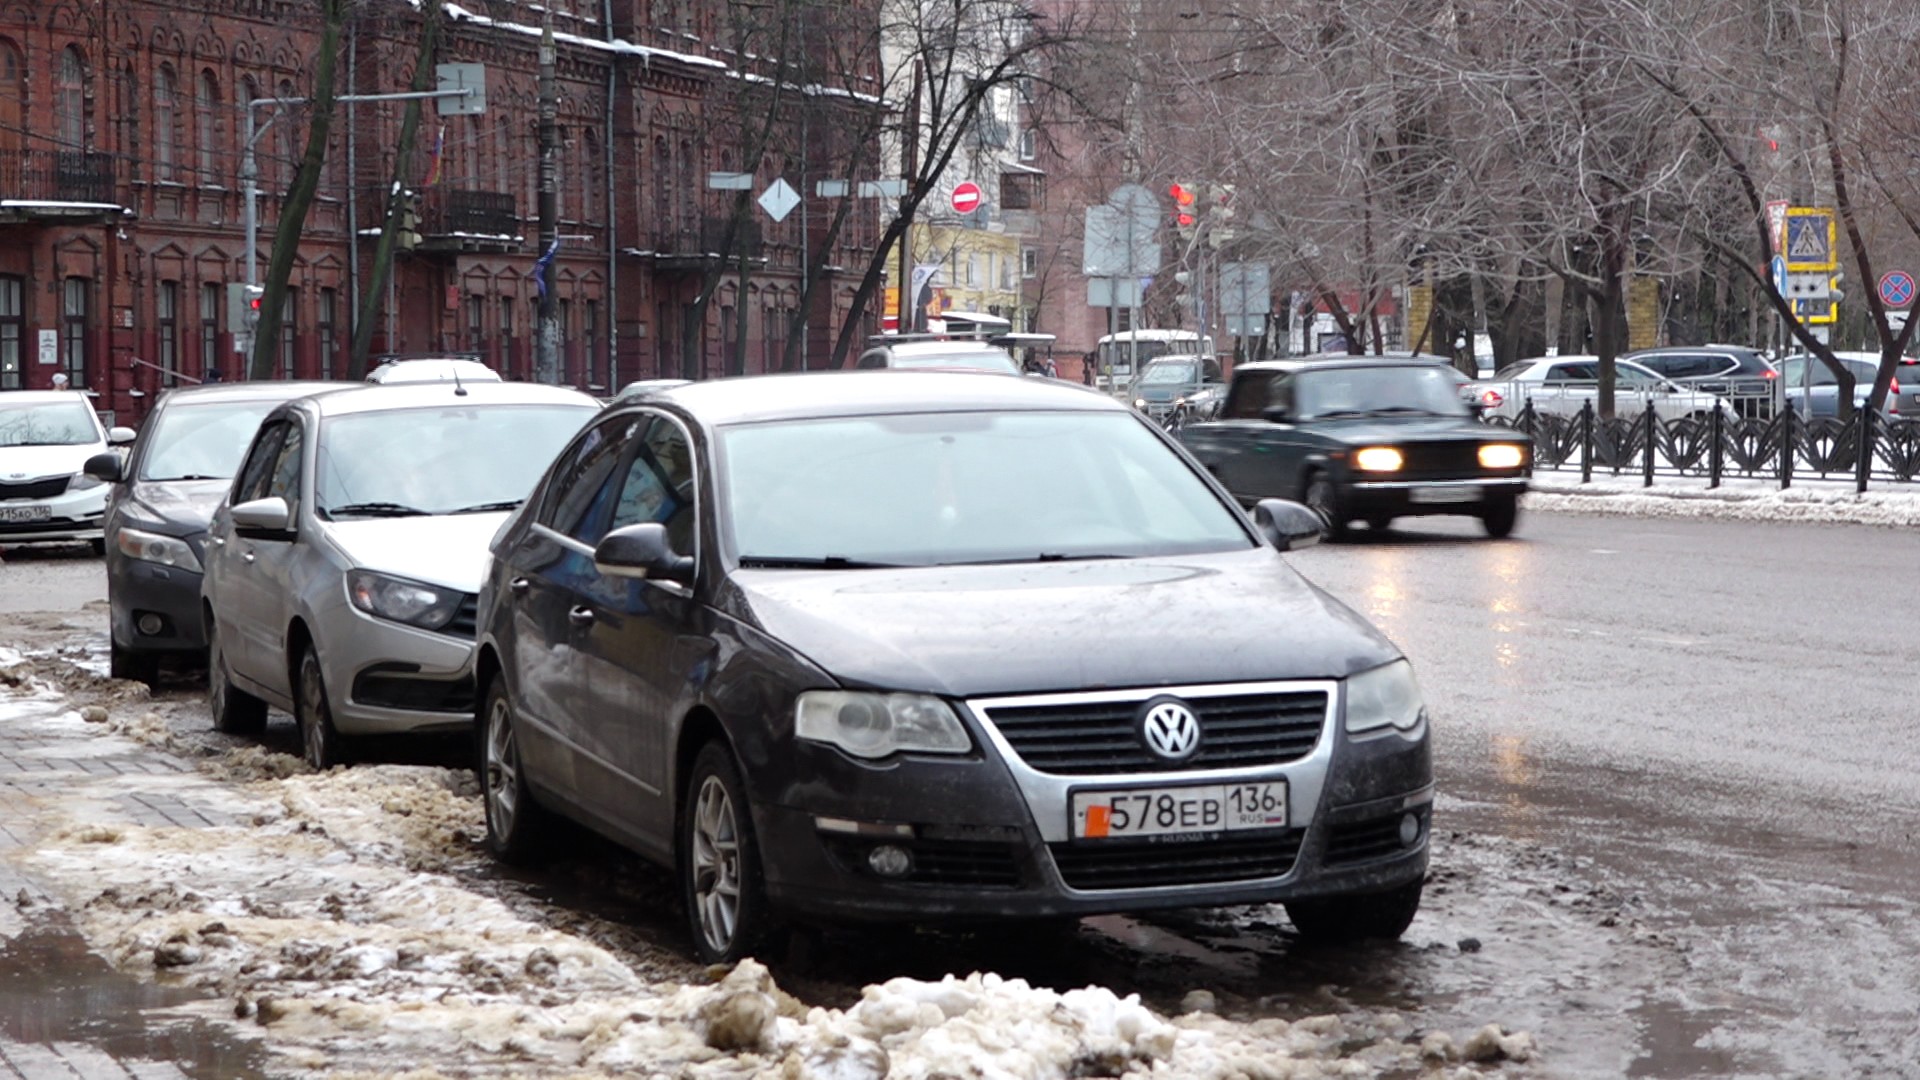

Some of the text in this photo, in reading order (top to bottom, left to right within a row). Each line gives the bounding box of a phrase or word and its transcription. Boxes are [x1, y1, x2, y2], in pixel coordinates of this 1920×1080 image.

[1146, 704, 1197, 757] VW
[1107, 785, 1276, 830] 578EB 136
[1239, 814, 1264, 824] RUS
